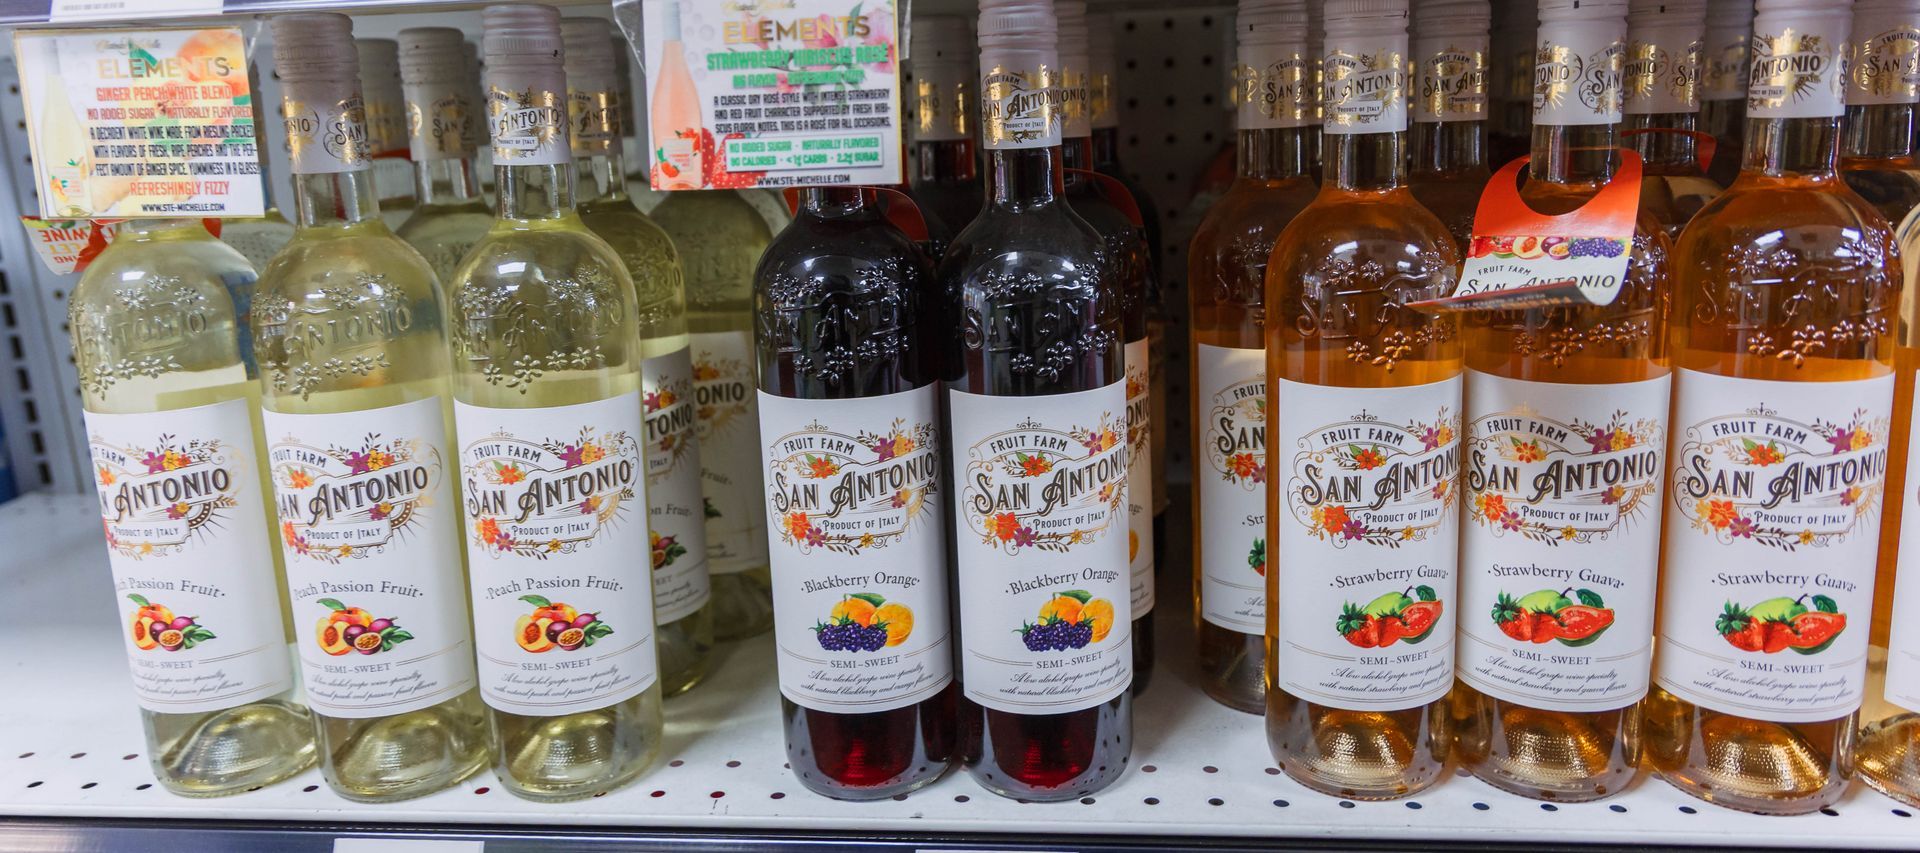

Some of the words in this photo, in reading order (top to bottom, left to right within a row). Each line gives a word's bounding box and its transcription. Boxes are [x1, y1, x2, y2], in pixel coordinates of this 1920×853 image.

[722, 15, 871, 45] ELEMENTS
[97, 56, 231, 80] ELEMENTS
[1751, 54, 1821, 87] ANTONIO
[1866, 55, 1900, 78] SAN
[1339, 72, 1404, 105] ANTONIO
[1423, 76, 1450, 98] SAN
[1536, 65, 1570, 85] TONIO
[1591, 69, 1620, 95] SAN
[201, 85, 232, 100] BLEND
[721, 95, 746, 106] CLASSIC
[782, 92, 801, 104] STYLE
[1265, 83, 1293, 103] SAN
[744, 107, 762, 119] FRUIT
[1005, 89, 1060, 121] ANTONIO
[499, 108, 559, 137] ANTONIO
[781, 120, 795, 131] THIS
[335, 122, 362, 145] SAN
[131, 181, 200, 196] REFRESHINGLY
[205, 181, 230, 196] FIZZY
[757, 174, 851, 186] WWW.STE-MICHELLE.COM
[1478, 265, 1504, 276] FRUIT
[1508, 264, 1531, 276] FARM
[697, 381, 745, 406] ONIO
[1233, 383, 1266, 400] FRUIT
[645, 403, 693, 442] TONIO
[1486, 418, 1522, 434] FRUIT
[1529, 421, 1568, 444] FARM
[1217, 416, 1266, 455] SAN
[1321, 427, 1361, 446] FRUIT
[1368, 428, 1405, 447] FARM
[1712, 421, 1757, 437] FRUIT
[1765, 423, 1808, 445] FARM
[474, 444, 501, 461] FRUIT
[508, 444, 542, 463] FARM
[784, 437, 814, 454] FRUIT
[821, 437, 855, 456] FARM
[990, 435, 1026, 454] FRUIT
[1034, 434, 1068, 452] FARM
[100, 447, 126, 467] FARM
[297, 450, 328, 468] FARM
[775, 471, 820, 514] SAN
[826, 451, 935, 518] ANTONIO
[1301, 463, 1362, 507] SAN
[1469, 449, 1520, 494] SAN
[1526, 450, 1657, 504] ANTONIO
[1687, 453, 1755, 500] SAN
[1760, 448, 1886, 510] ANTONIO
[114, 467, 230, 524] ANTONIO
[276, 491, 301, 520] AN
[307, 465, 429, 527] ANTONIO
[468, 477, 507, 519] SAN
[515, 459, 632, 525] ANTONIO
[974, 472, 1030, 515] SAN
[822, 519, 861, 531] PRODUCT
[865, 520, 875, 529] OF
[878, 515, 900, 529] ITALY
[1033, 518, 1072, 531] PRODUCT
[1075, 517, 1084, 525] OF
[1088, 510, 1105, 525] ITALY
[1363, 512, 1404, 525] PRODUCT
[1407, 512, 1417, 521] OF
[1420, 507, 1439, 521] ITALY
[1521, 505, 1565, 520] PRODUCT
[1569, 512, 1581, 522] OF
[1584, 511, 1610, 523] ITALY
[1754, 510, 1801, 525] PRODUCT
[1807, 515, 1818, 525] OF
[1822, 513, 1847, 526] ITALY
[144, 529, 153, 537] OF
[157, 526, 180, 538] ITALY
[306, 529, 340, 541] PRODUCT
[344, 530, 353, 539] OF
[357, 527, 381, 540] ITALY
[511, 525, 549, 537] PRODUCT
[553, 525, 563, 534] OF
[567, 522, 590, 535] ITALY
[1335, 568, 1413, 589] Strawberry
[1492, 563, 1573, 582] Strawberry
[1717, 570, 1810, 589] Strawberry
[128, 577, 174, 591] Passion
[321, 579, 374, 594] Passion
[525, 575, 580, 591] Passion
[803, 574, 870, 594] Blackberry
[1009, 572, 1079, 595] Blackberry
[1512, 664, 1546, 676] alcohol
